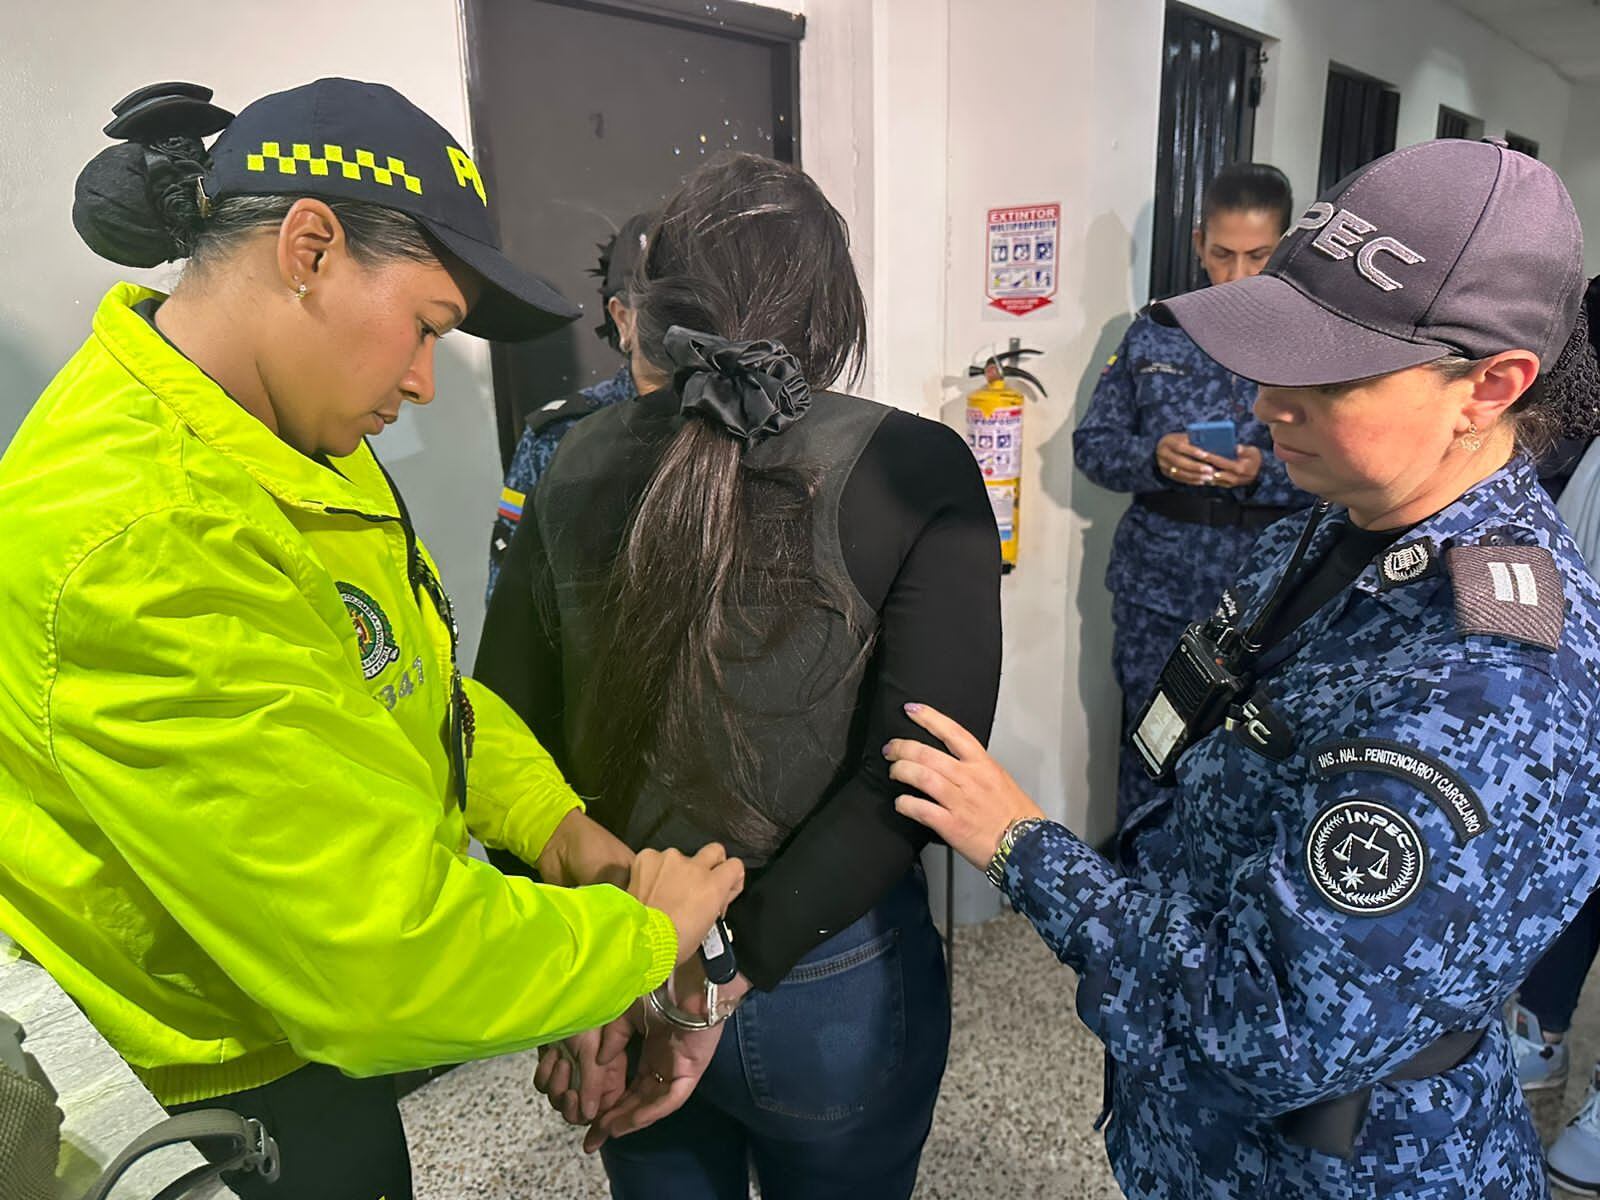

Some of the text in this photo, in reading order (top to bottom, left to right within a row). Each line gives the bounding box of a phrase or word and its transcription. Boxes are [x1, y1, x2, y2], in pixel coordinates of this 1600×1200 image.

[991, 208, 1055, 222] EXTINTOR
[1364, 747, 1434, 780] PENITENCIARIO
[1430, 771, 1442, 784] Y
[1436, 777, 1482, 834] CARCELARIO
